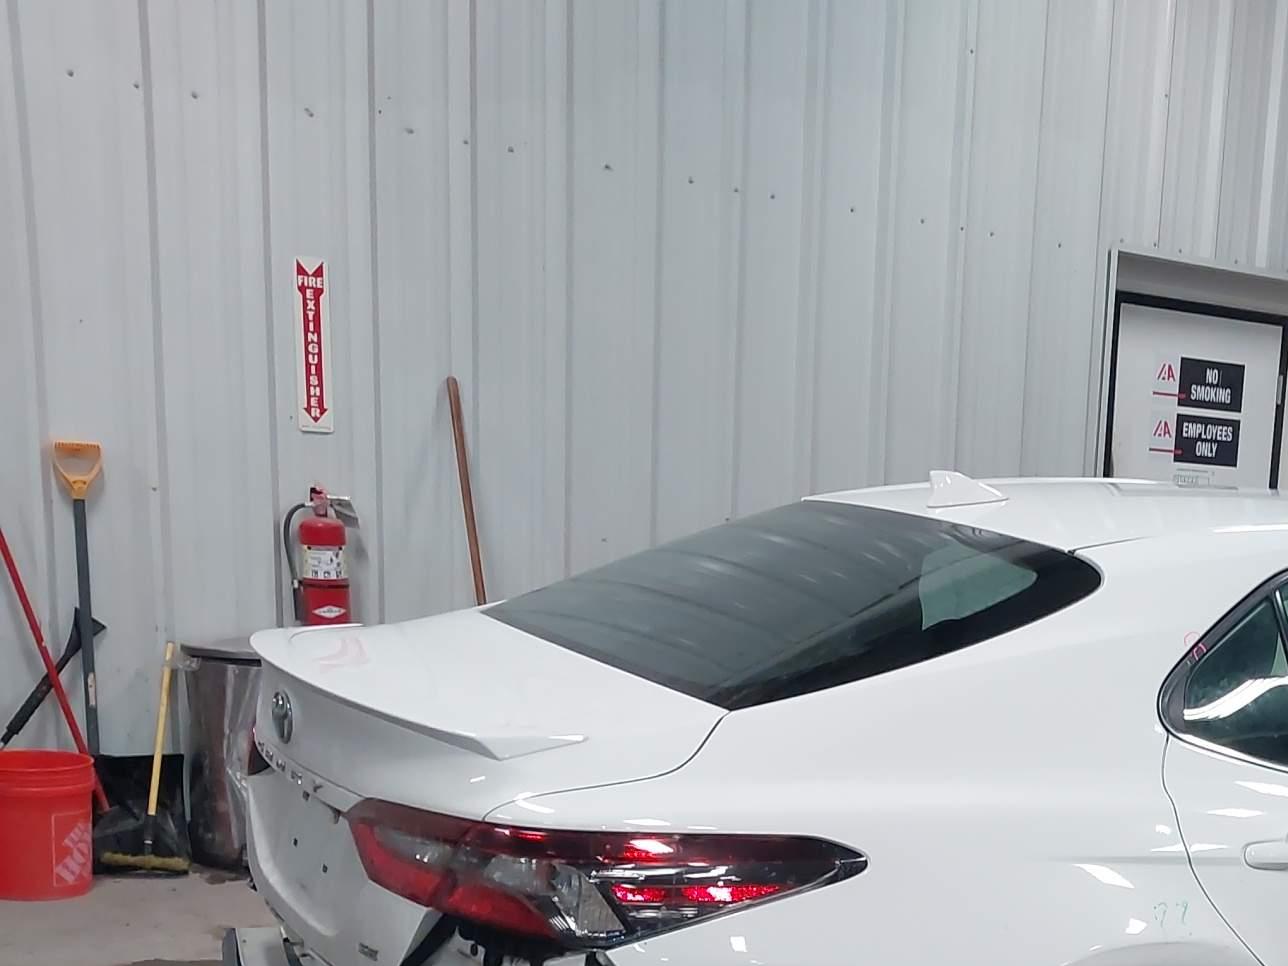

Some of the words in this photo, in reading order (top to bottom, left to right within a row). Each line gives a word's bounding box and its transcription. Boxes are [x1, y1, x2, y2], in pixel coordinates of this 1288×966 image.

[297, 275, 324, 289] FIRE
[305, 288, 321, 418] EXTINGUISHER
[1205, 367, 1219, 385] NO
[1190, 384, 1231, 404] SMOKING
[1182, 422, 1233, 441] EMPLOYEES
[1195, 441, 1218, 458] ONLY
